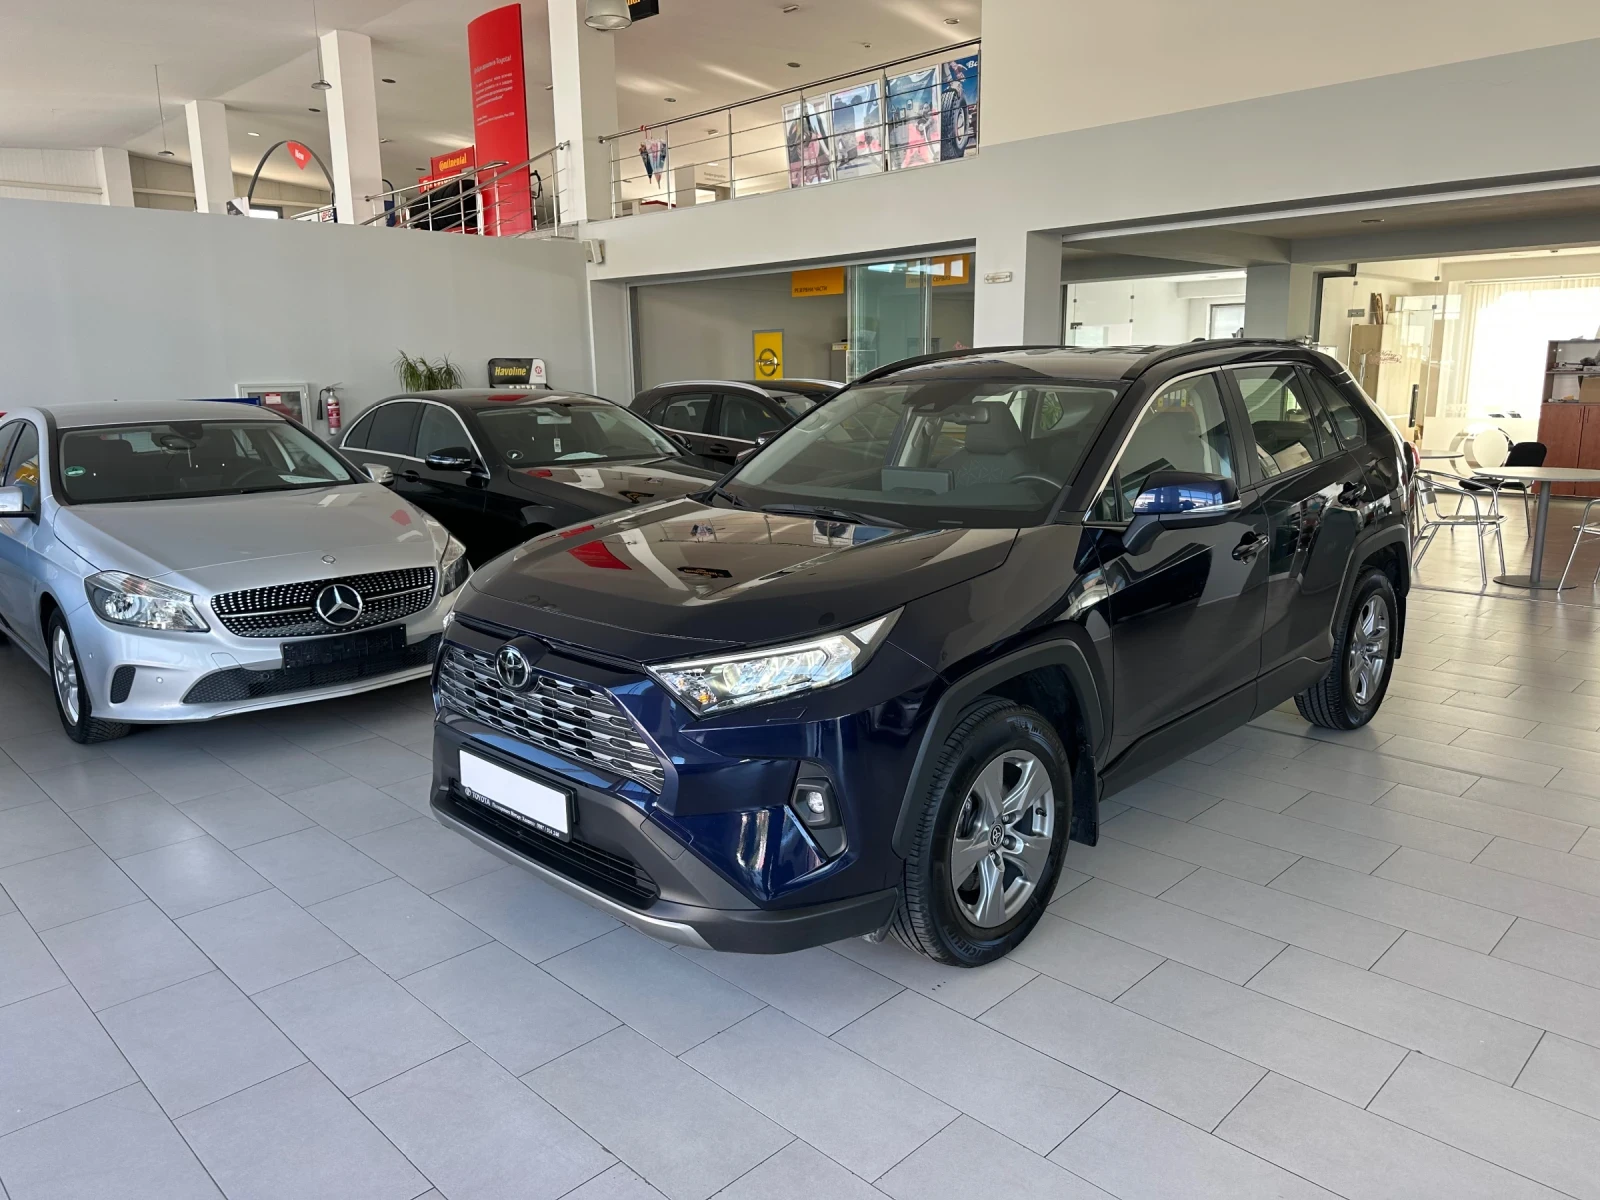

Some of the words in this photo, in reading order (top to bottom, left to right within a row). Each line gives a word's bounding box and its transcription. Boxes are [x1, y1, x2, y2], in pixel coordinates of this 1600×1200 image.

[295, 149, 304, 160] New
[439, 153, 467, 171] Continental
[495, 366, 527, 376] Havoline
[472, 792, 491, 806] TOYOTA
